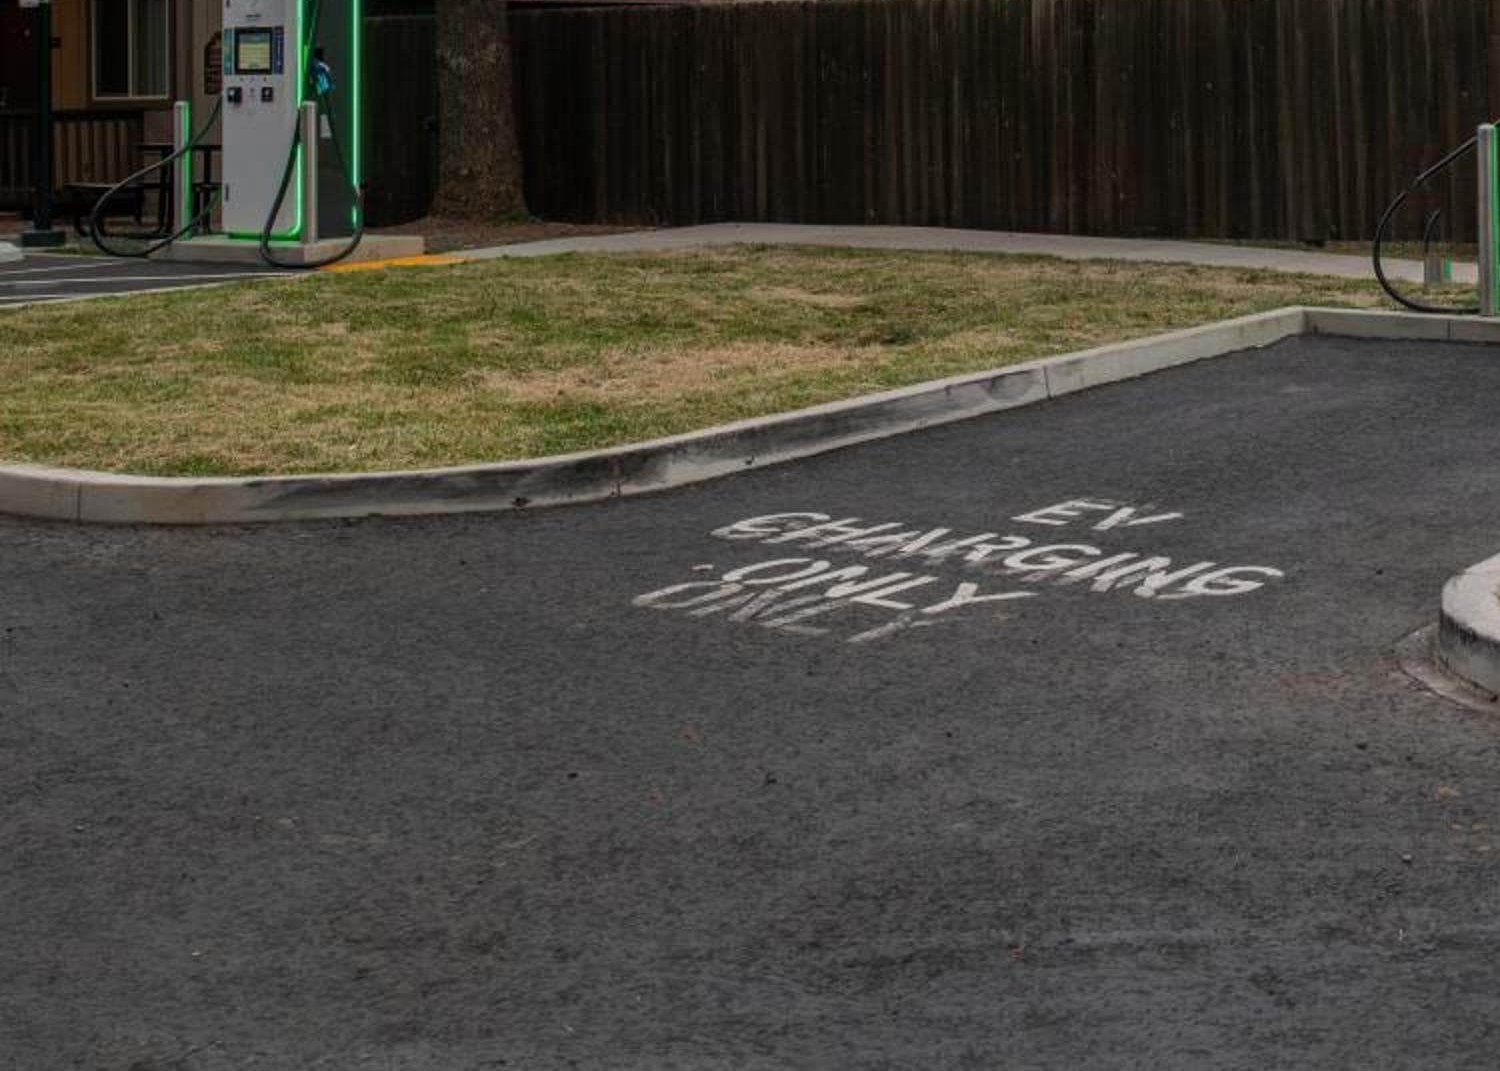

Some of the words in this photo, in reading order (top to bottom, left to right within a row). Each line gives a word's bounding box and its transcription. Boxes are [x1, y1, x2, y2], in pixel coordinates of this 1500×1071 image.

[1011, 500, 1184, 530] EV
[706, 512, 1284, 600] CHARGING
[722, 558, 1039, 613] ONLY
